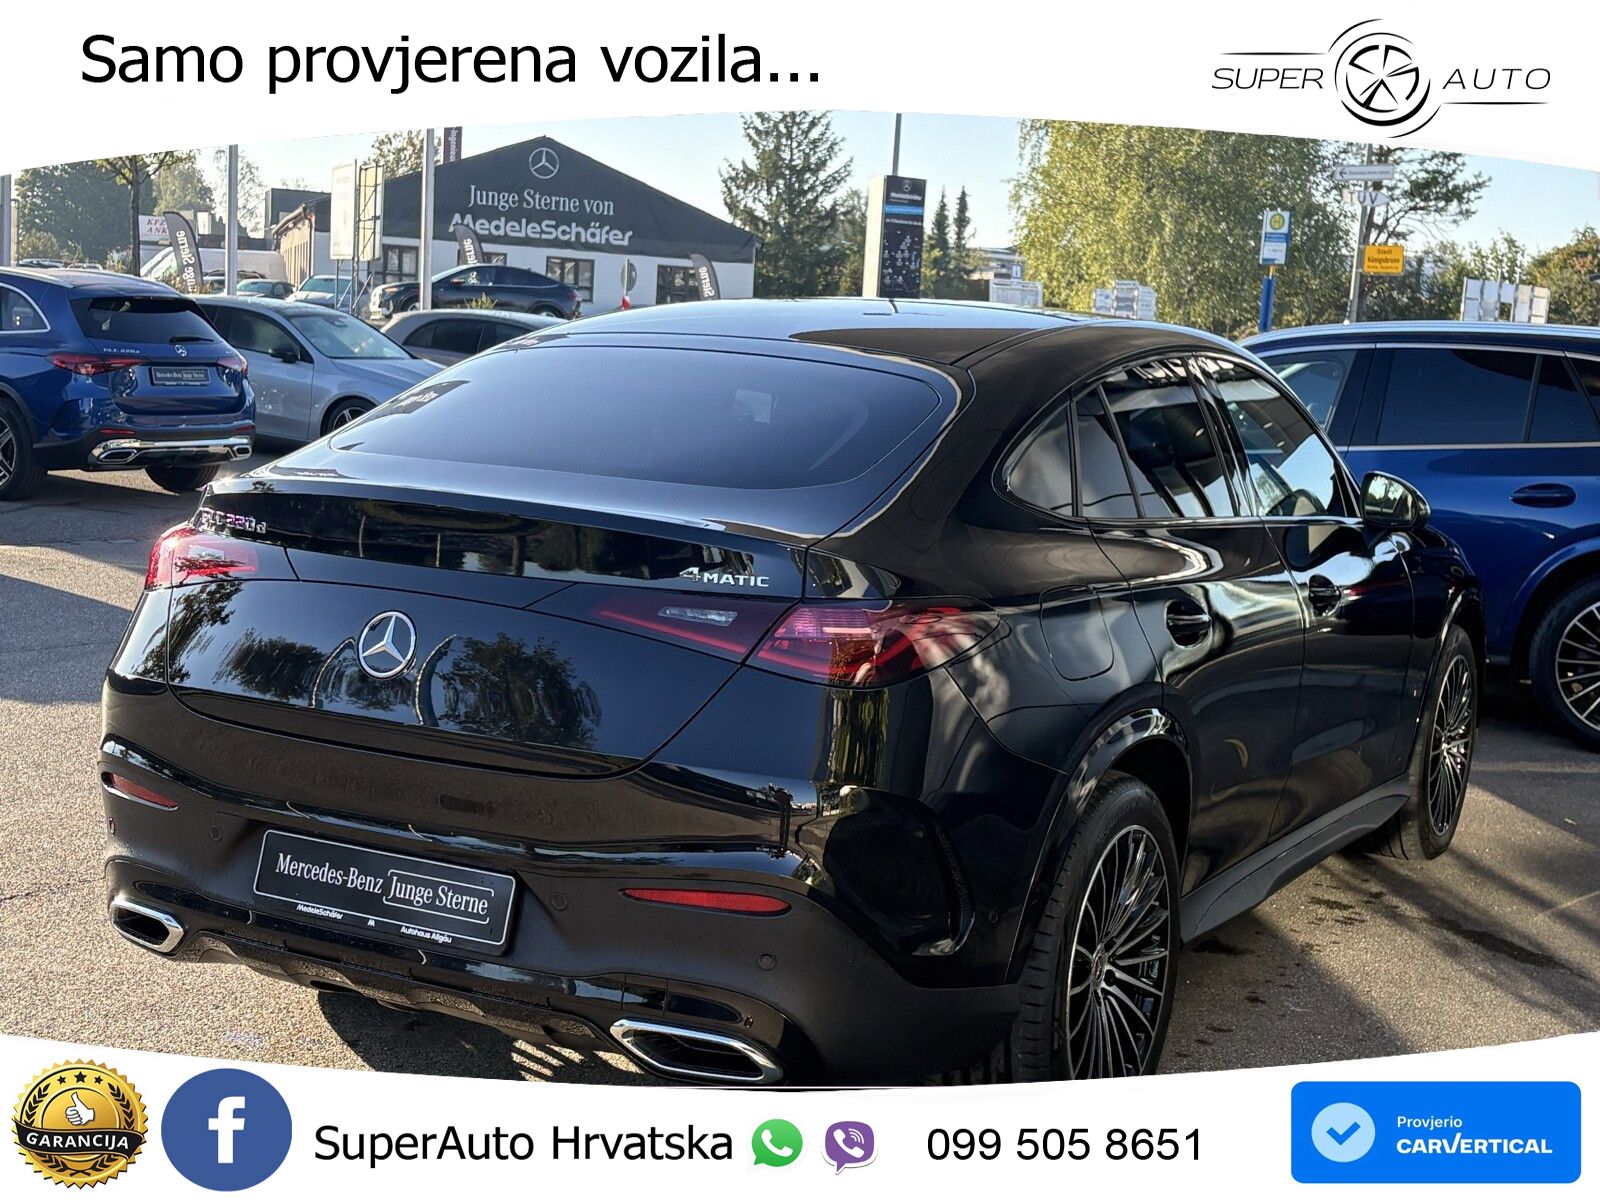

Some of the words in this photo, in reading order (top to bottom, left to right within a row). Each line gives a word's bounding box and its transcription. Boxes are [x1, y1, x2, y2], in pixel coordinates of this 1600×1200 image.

[468, 184, 519, 212] Junge
[523, 188, 580, 213] Sterne
[584, 199, 614, 216] von
[147, 226, 167, 234] ANK
[448, 213, 633, 246] MedeleSchäfer
[679, 567, 770, 587] 4MATIC
[275, 852, 384, 894] Mercedes-Benz
[388, 875, 433, 907] Junge
[435, 885, 489, 915] Sterne
[296, 904, 344, 920] MedeleSchäfer
[400, 926, 431, 939] Autohaus
[431, 932, 453, 944] Allgäu
